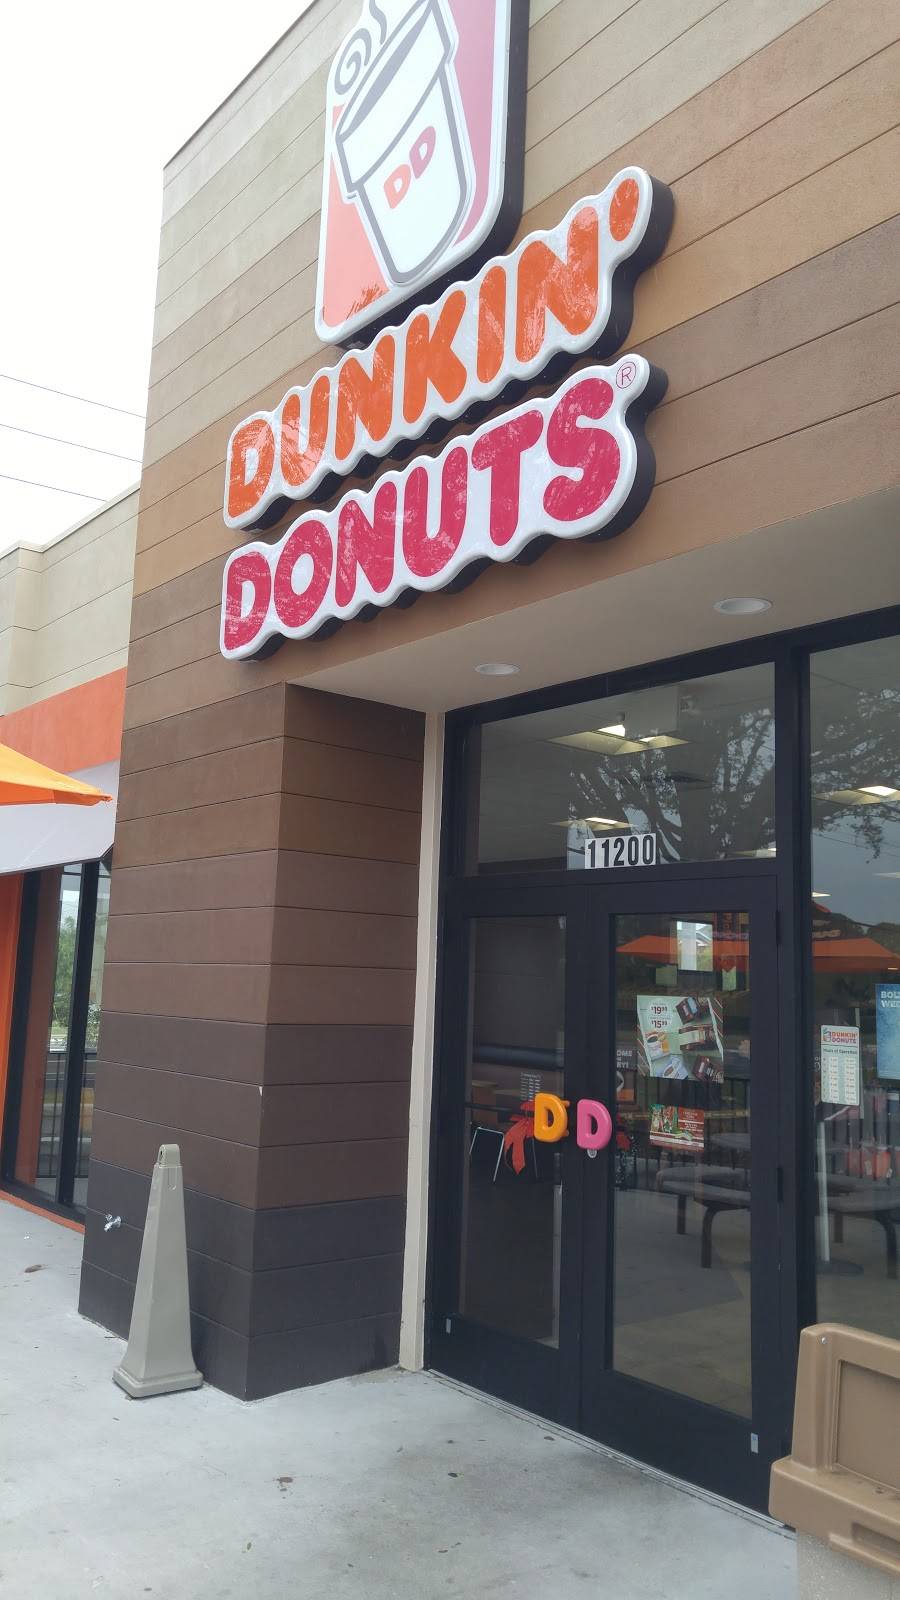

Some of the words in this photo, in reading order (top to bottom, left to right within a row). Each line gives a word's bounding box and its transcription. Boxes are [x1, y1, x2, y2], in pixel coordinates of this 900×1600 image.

[227, 178, 640, 519] DUNKIN'
[225, 377, 621, 650] DONUTS
[588, 834, 653, 868] 11200
